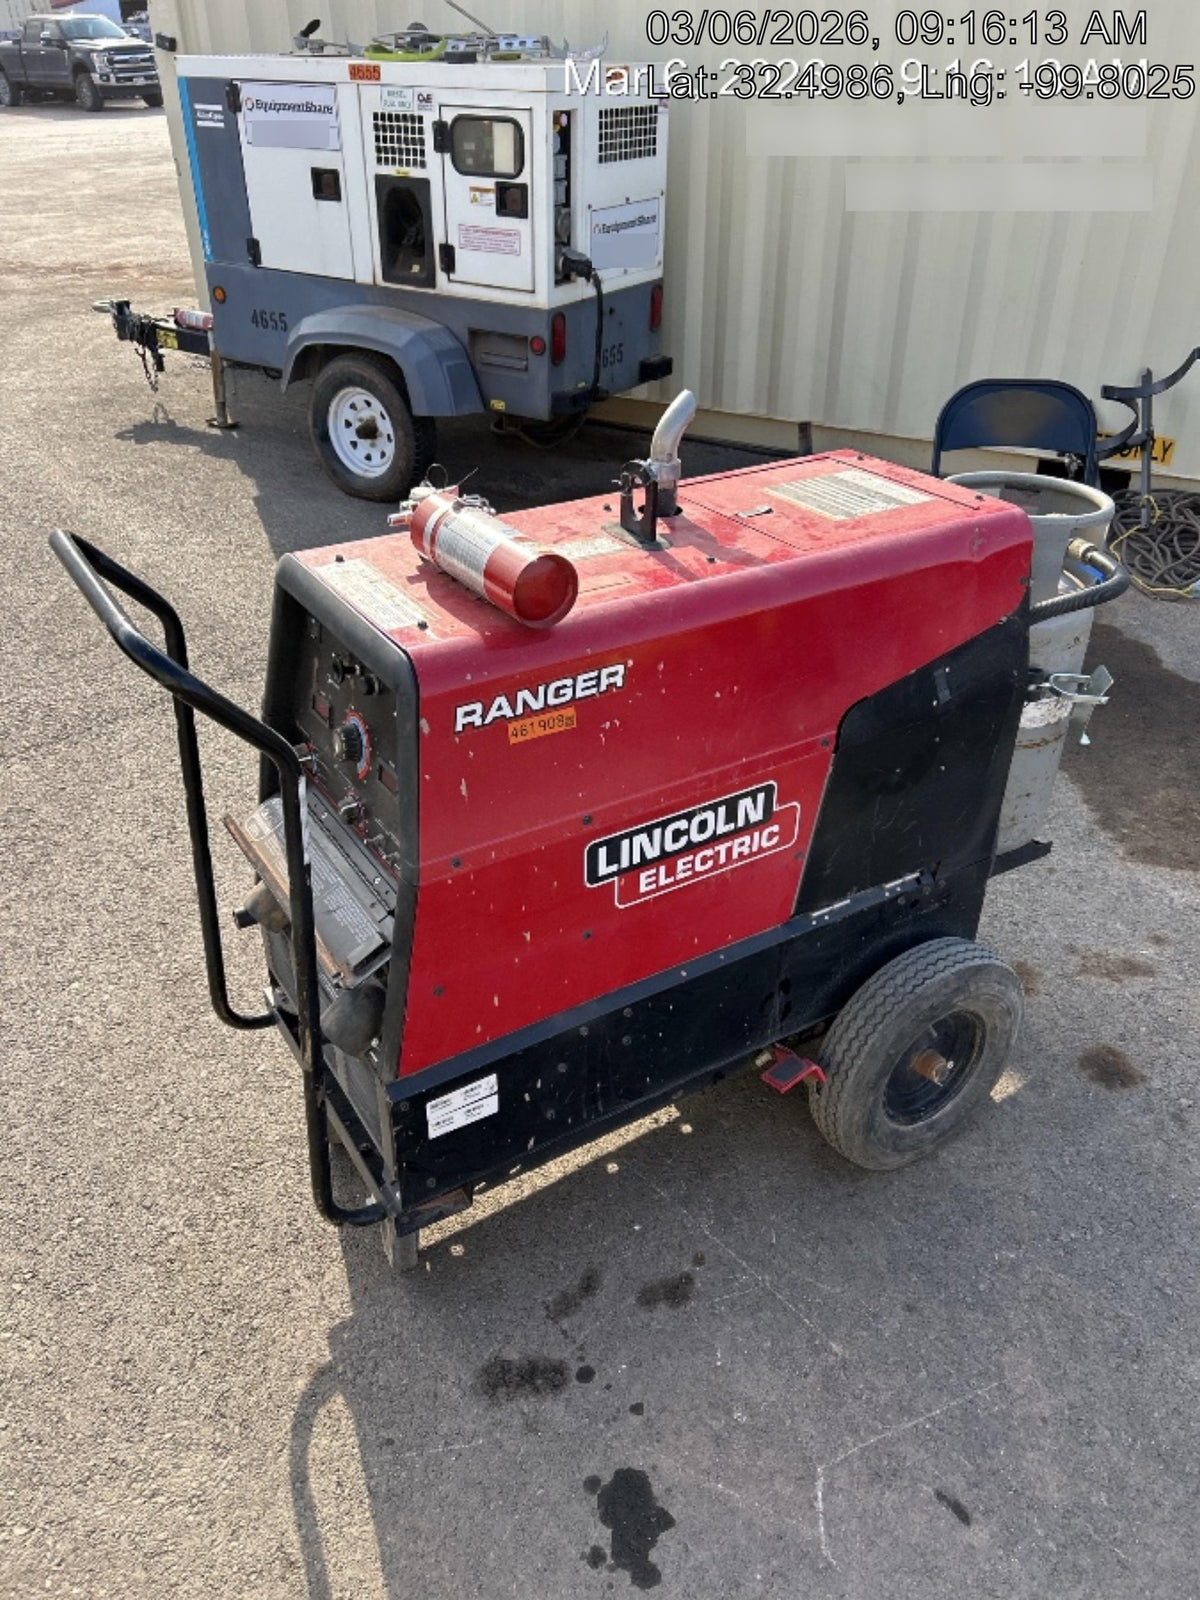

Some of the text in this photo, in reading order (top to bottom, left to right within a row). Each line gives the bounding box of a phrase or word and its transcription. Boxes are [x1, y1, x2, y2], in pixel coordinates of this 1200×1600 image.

[255, 99, 333, 114] EquipmentShare
[251, 309, 288, 332] 4655
[454, 663, 626, 733] RANGER
[511, 714, 565, 739] 461908
[597, 792, 766, 878] LINCOLN
[638, 824, 781, 894] ELECTRIC
